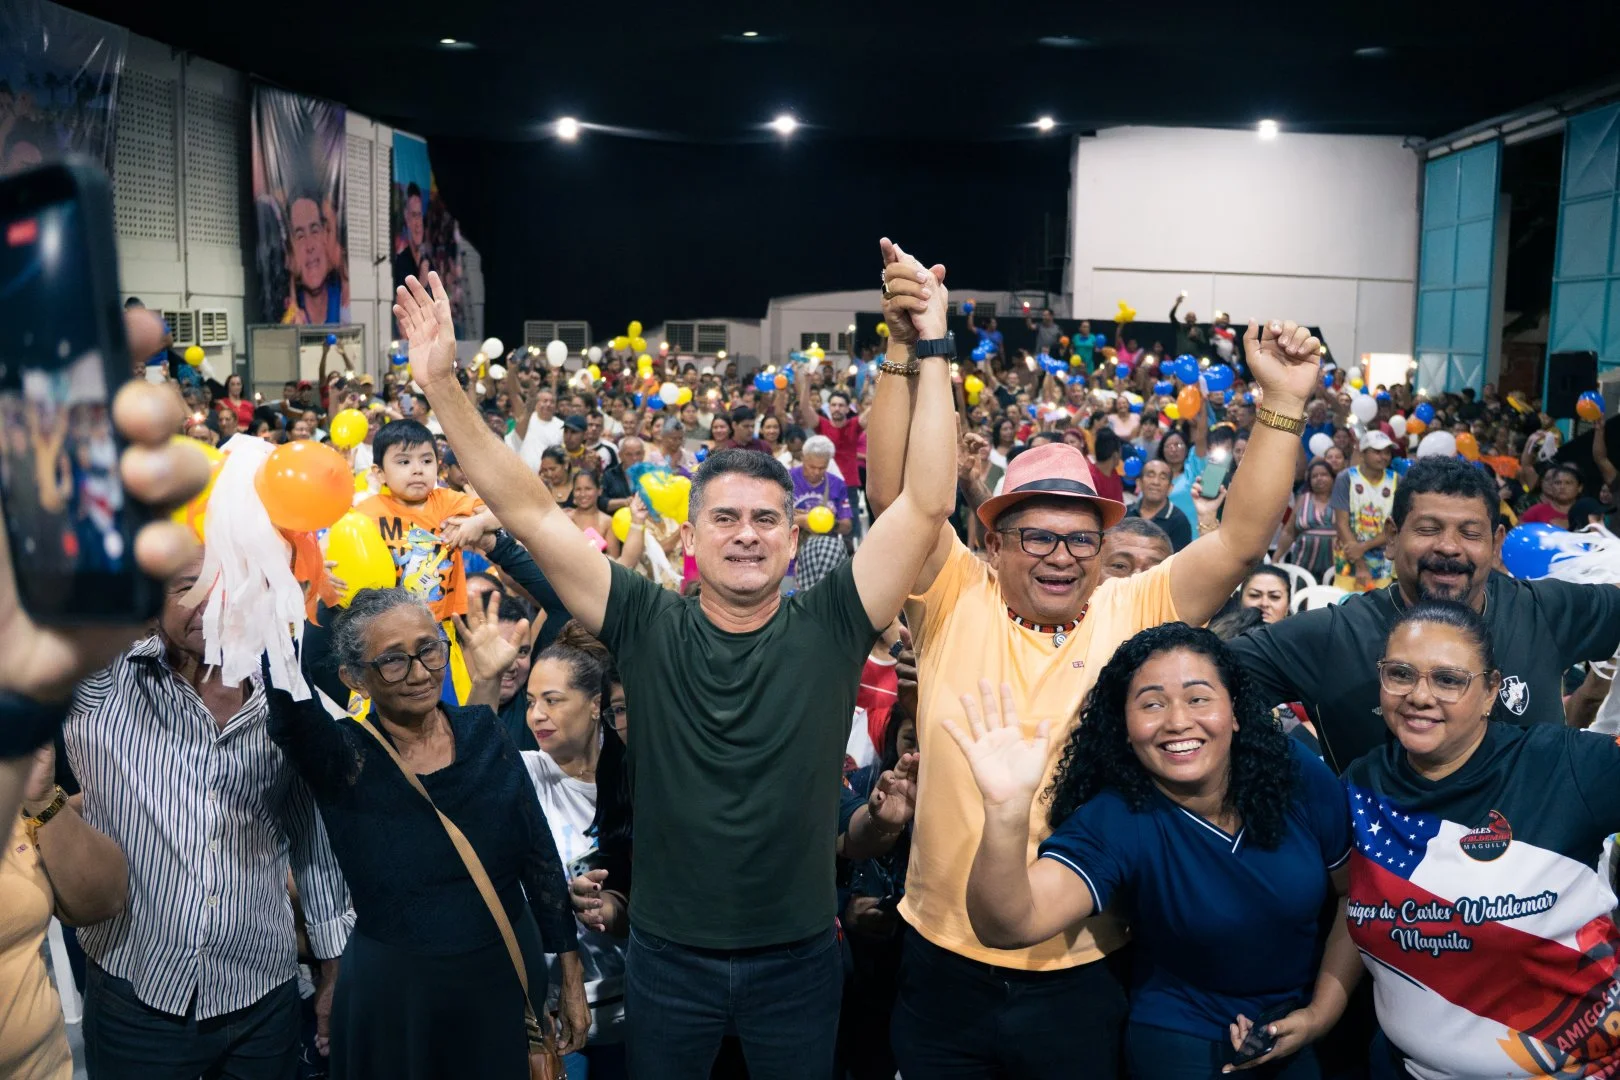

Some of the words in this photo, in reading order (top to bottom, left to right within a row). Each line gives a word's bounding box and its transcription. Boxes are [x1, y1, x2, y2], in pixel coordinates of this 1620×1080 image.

[1463, 841, 1507, 850] MAGUILA
[1379, 901, 1397, 920] do
[1401, 899, 1452, 923] Carles
[1456, 892, 1555, 924] Waldemar
[1391, 928, 1471, 956] Maguila
[1556, 991, 1615, 1056] AMIGOS
